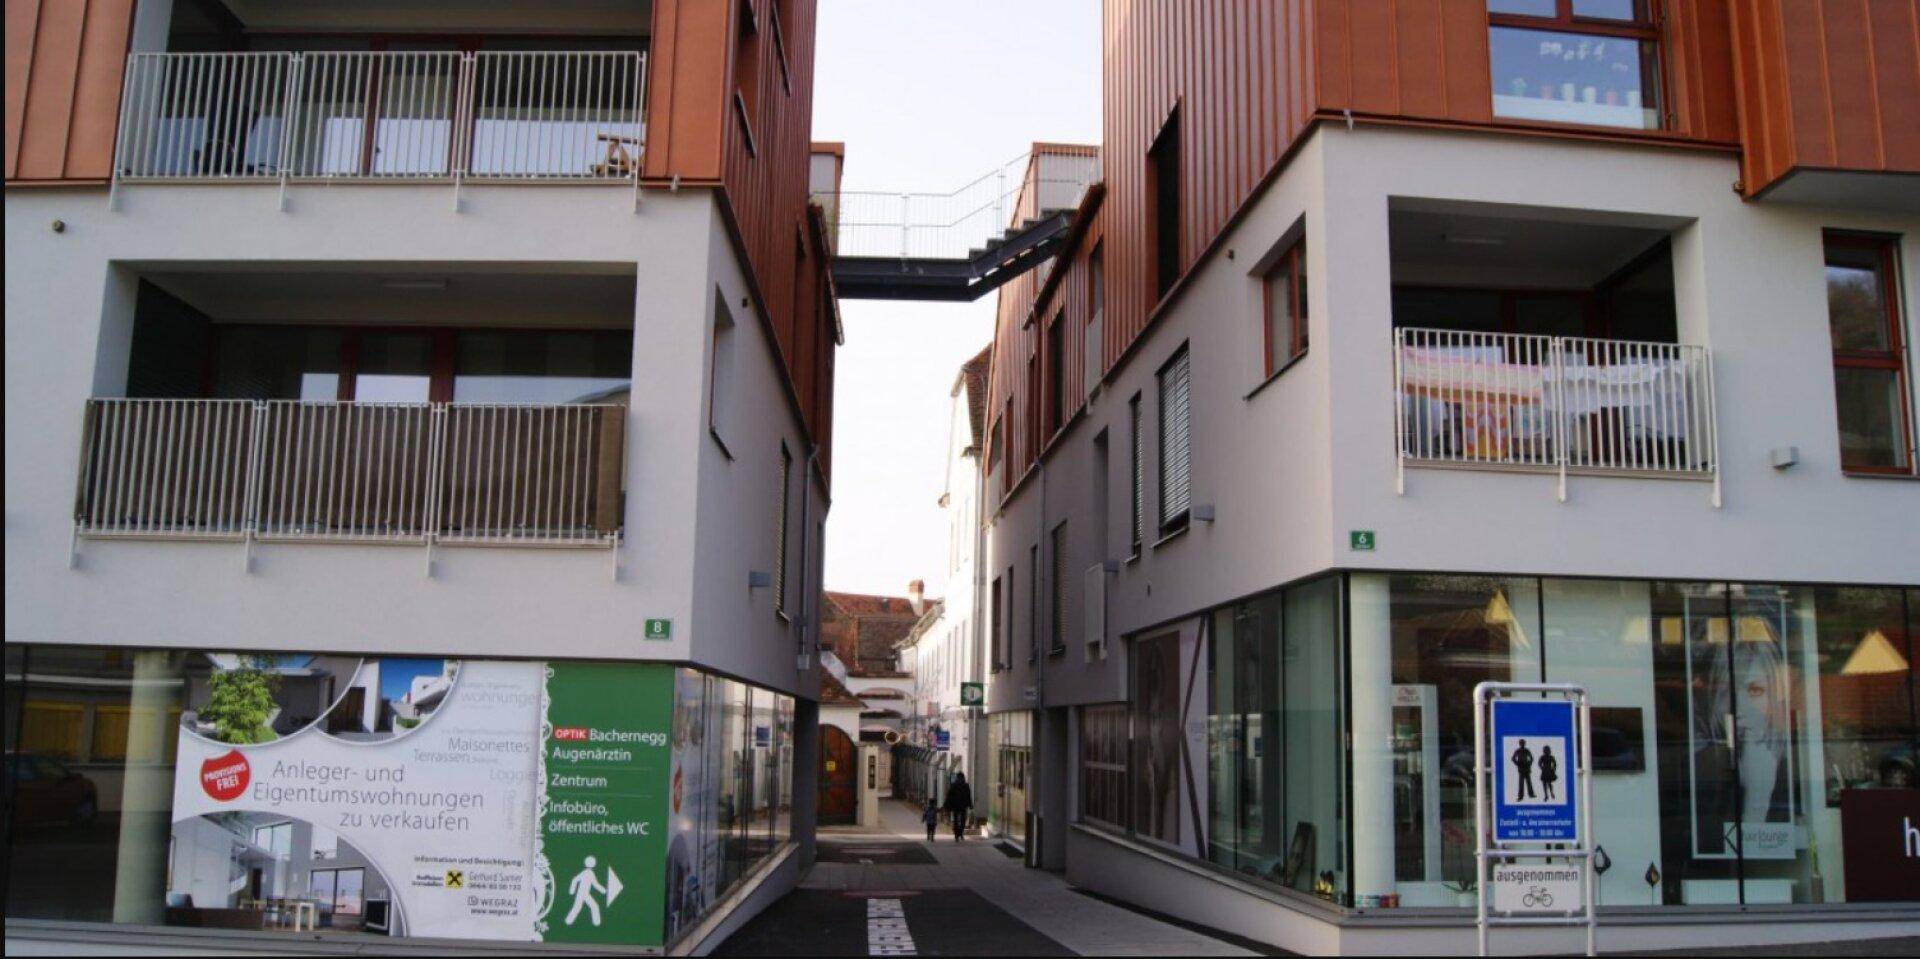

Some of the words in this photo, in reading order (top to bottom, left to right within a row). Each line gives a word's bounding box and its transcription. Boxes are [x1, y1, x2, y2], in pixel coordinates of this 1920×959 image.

[1359, 533, 1366, 544] 6
[654, 621, 662, 633] 8
[448, 737, 530, 753] Maisonettes
[554, 728, 588, 739] OPTIK
[589, 728, 667, 747] Bachernegg
[413, 748, 471, 762] Terrassen
[553, 746, 632, 763] Augenärztin
[272, 760, 358, 783] Anleger-
[365, 765, 404, 782] und
[216, 774, 241, 791] FREI
[551, 773, 608, 788] Zentrum
[254, 782, 484, 811] Eigentumswohnungen
[549, 801, 609, 816] Infobüro,
[339, 812, 362, 828] zu
[370, 812, 470, 831] verkaufen
[548, 820, 624, 835] öffentliches
[626, 821, 650, 835] WC
[1904, 816, 1920, 858] h
[1497, 870, 1579, 884] ausgenommen
